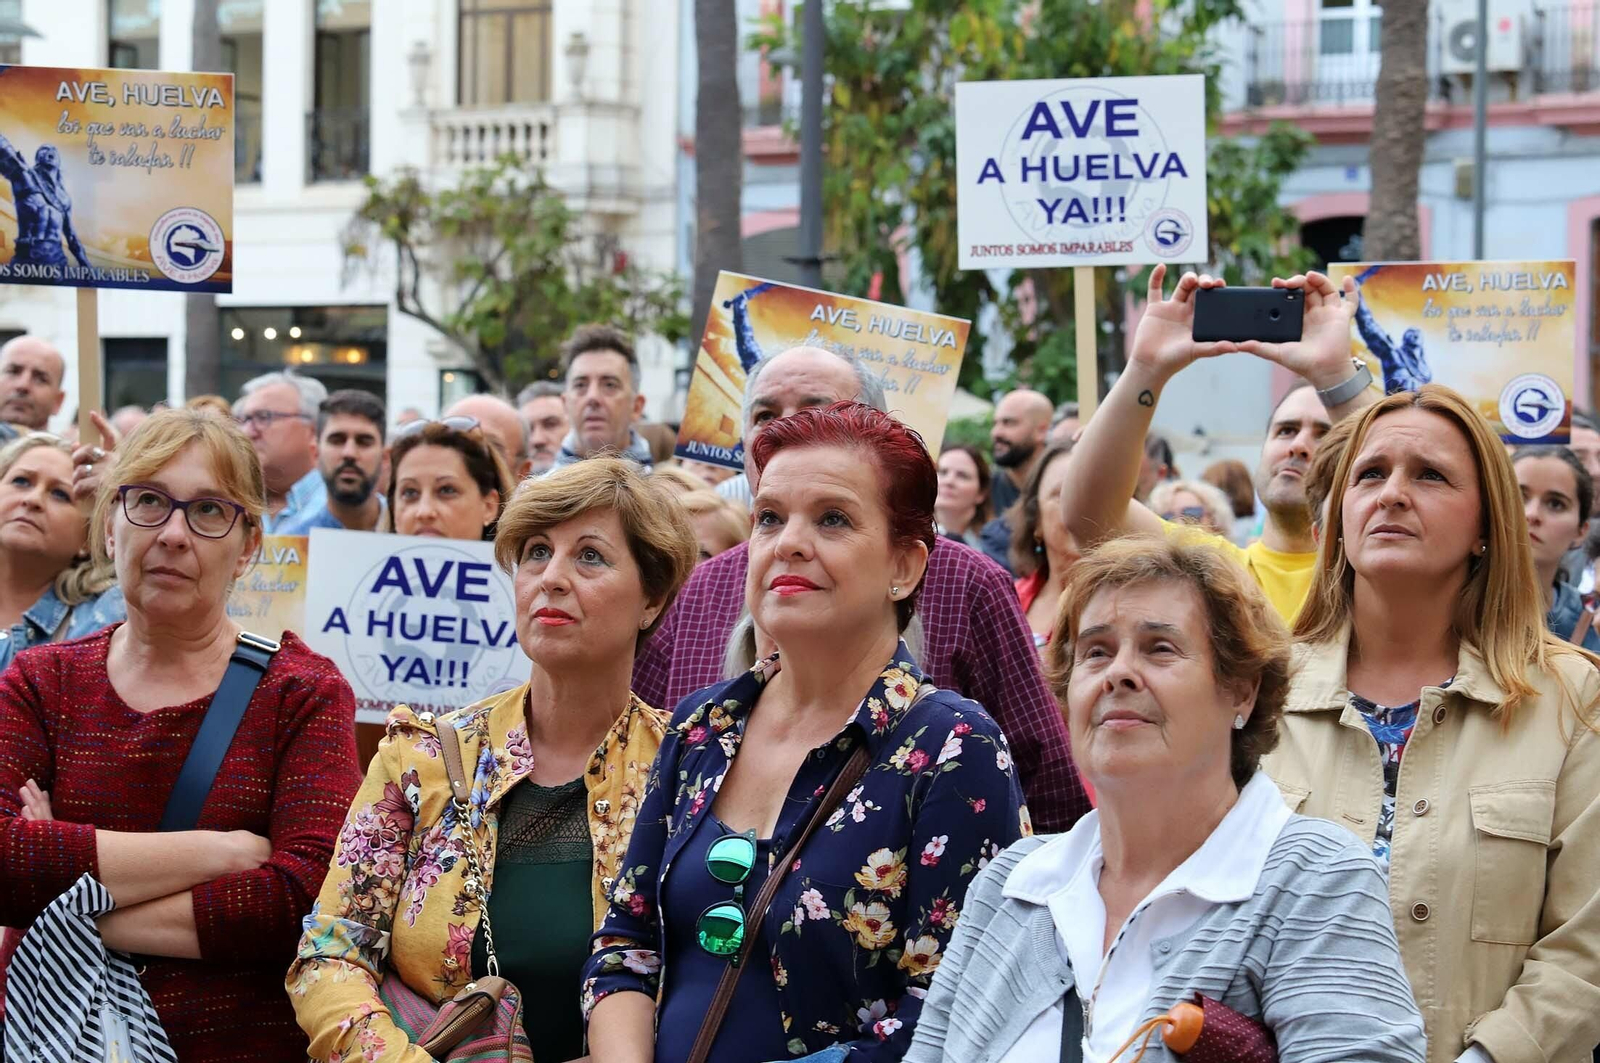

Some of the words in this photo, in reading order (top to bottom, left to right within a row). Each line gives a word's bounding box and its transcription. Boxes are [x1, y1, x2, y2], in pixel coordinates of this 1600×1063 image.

[56, 81, 116, 107] AVE,
[123, 83, 225, 109] HUELVA
[57, 110, 82, 134] los
[86, 121, 115, 147] que
[118, 122, 149, 137] van
[152, 127, 166, 138] a
[168, 114, 225, 139] luchar
[1021, 99, 1139, 140] AVE
[89, 143, 106, 165] te
[109, 141, 174, 174] saludan
[180, 144, 195, 168] !!
[977, 158, 1006, 184] A
[1021, 152, 1188, 182] HUELVA
[1036, 196, 1126, 224] YA!!!
[970, 245, 1014, 257] JUNTOS
[1017, 243, 1057, 256] SOMOS
[1060, 241, 1134, 255] IMPARABLES
[13, 263, 61, 278] SOMOS
[64, 266, 150, 282] IMPARABLES
[1422, 273, 1473, 293] AVE,
[1480, 272, 1568, 291] HUELVA
[810, 303, 862, 332] AVE,
[868, 314, 957, 349] HUELVA
[902, 348, 952, 375] luchar
[685, 440, 732, 461] JUNTOS
[371, 556, 492, 603] AVE
[321, 607, 351, 635] A
[380, 654, 469, 688] YA!!!
